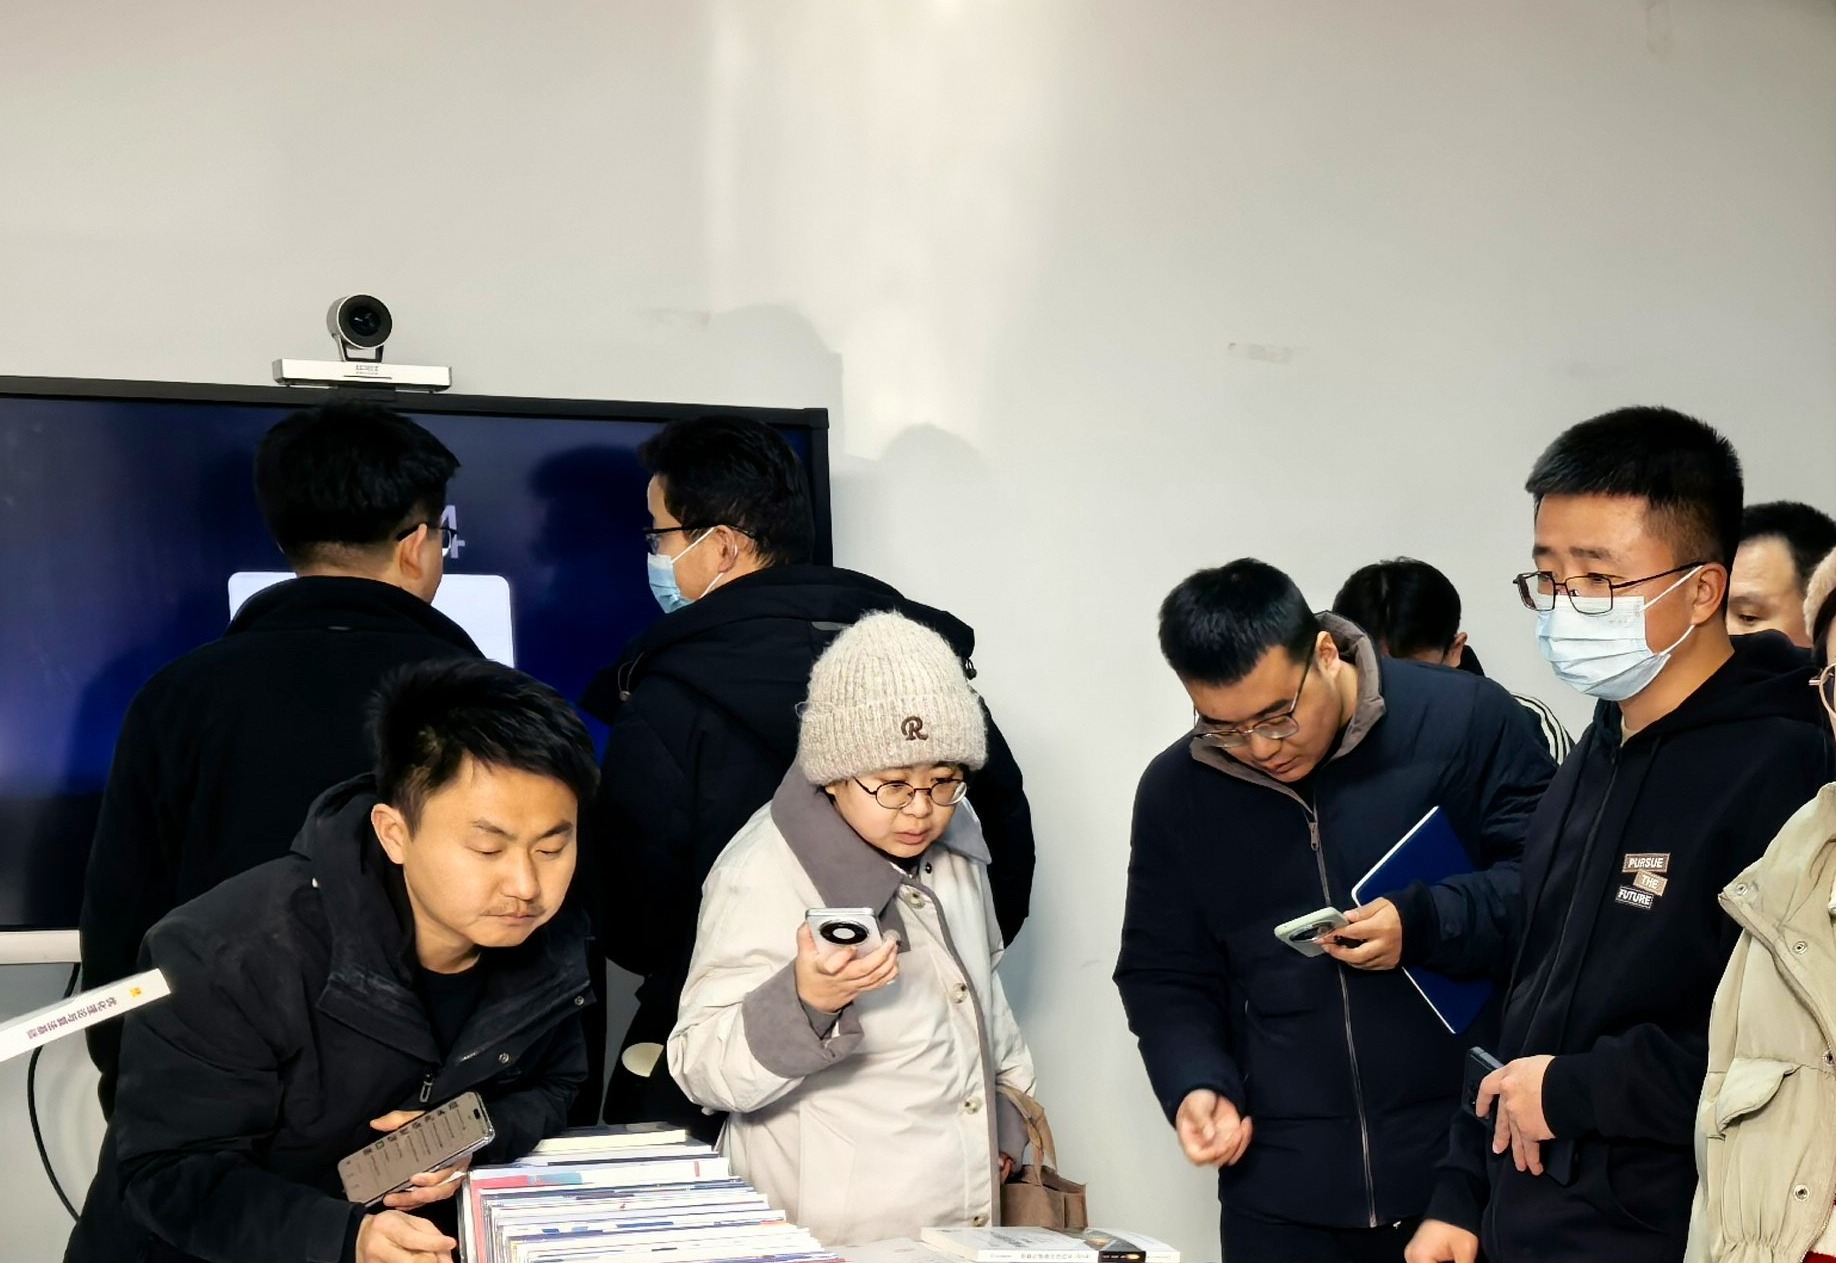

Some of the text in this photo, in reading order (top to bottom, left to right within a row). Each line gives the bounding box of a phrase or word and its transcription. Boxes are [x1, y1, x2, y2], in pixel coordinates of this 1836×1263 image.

[900, 714, 929, 742] R
[1627, 854, 1665, 870] PURSUE
[1641, 872, 1658, 890] THE
[1617, 888, 1652, 906] FUTURE
